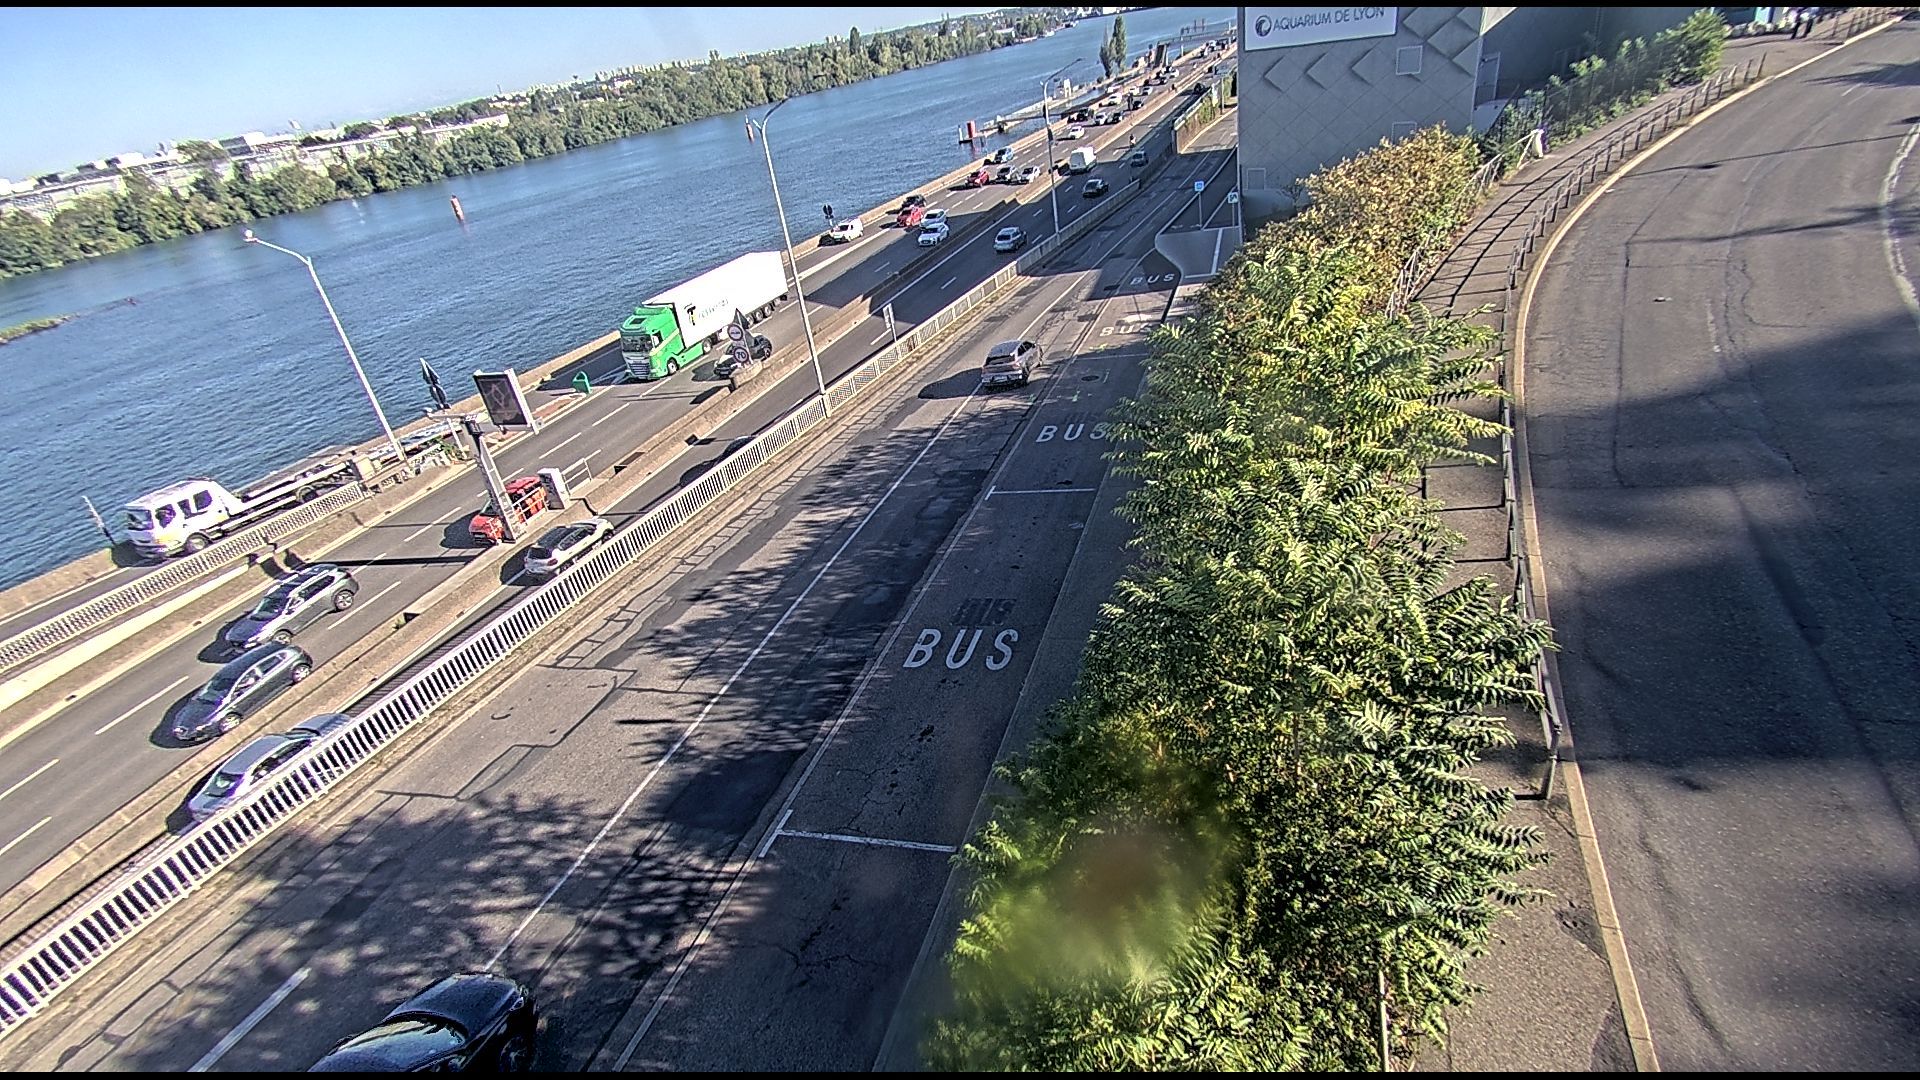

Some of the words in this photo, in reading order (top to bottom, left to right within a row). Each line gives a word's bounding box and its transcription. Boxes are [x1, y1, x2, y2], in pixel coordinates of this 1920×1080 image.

[1273, 12, 1331, 31] AQUARIUM
[1334, 9, 1350, 23] DE
[1353, 7, 1385, 20] LYON
[1131, 274, 1175, 285] BUS
[1036, 422, 1107, 442] BUS
[902, 628, 1018, 670] BUS
